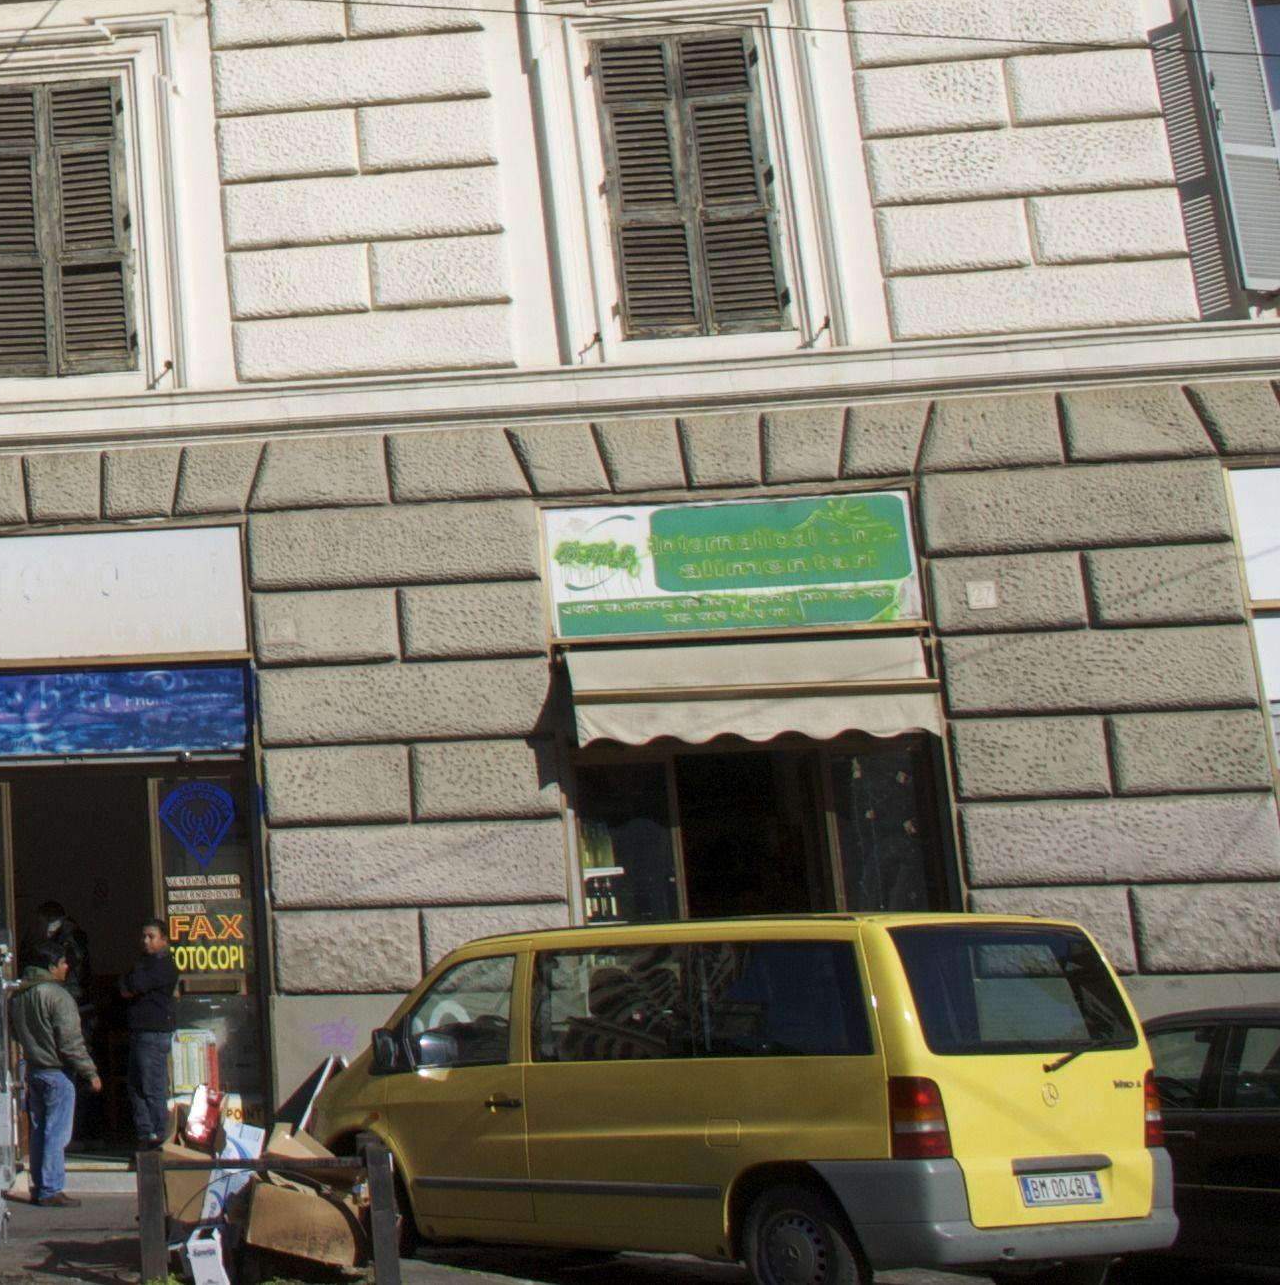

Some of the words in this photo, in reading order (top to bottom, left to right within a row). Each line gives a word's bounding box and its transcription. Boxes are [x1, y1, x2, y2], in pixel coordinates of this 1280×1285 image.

[169, 914, 244, 941] FAX
[170, 945, 244, 971] OTOCOPI
[1030, 1179, 1049, 1199] BM
